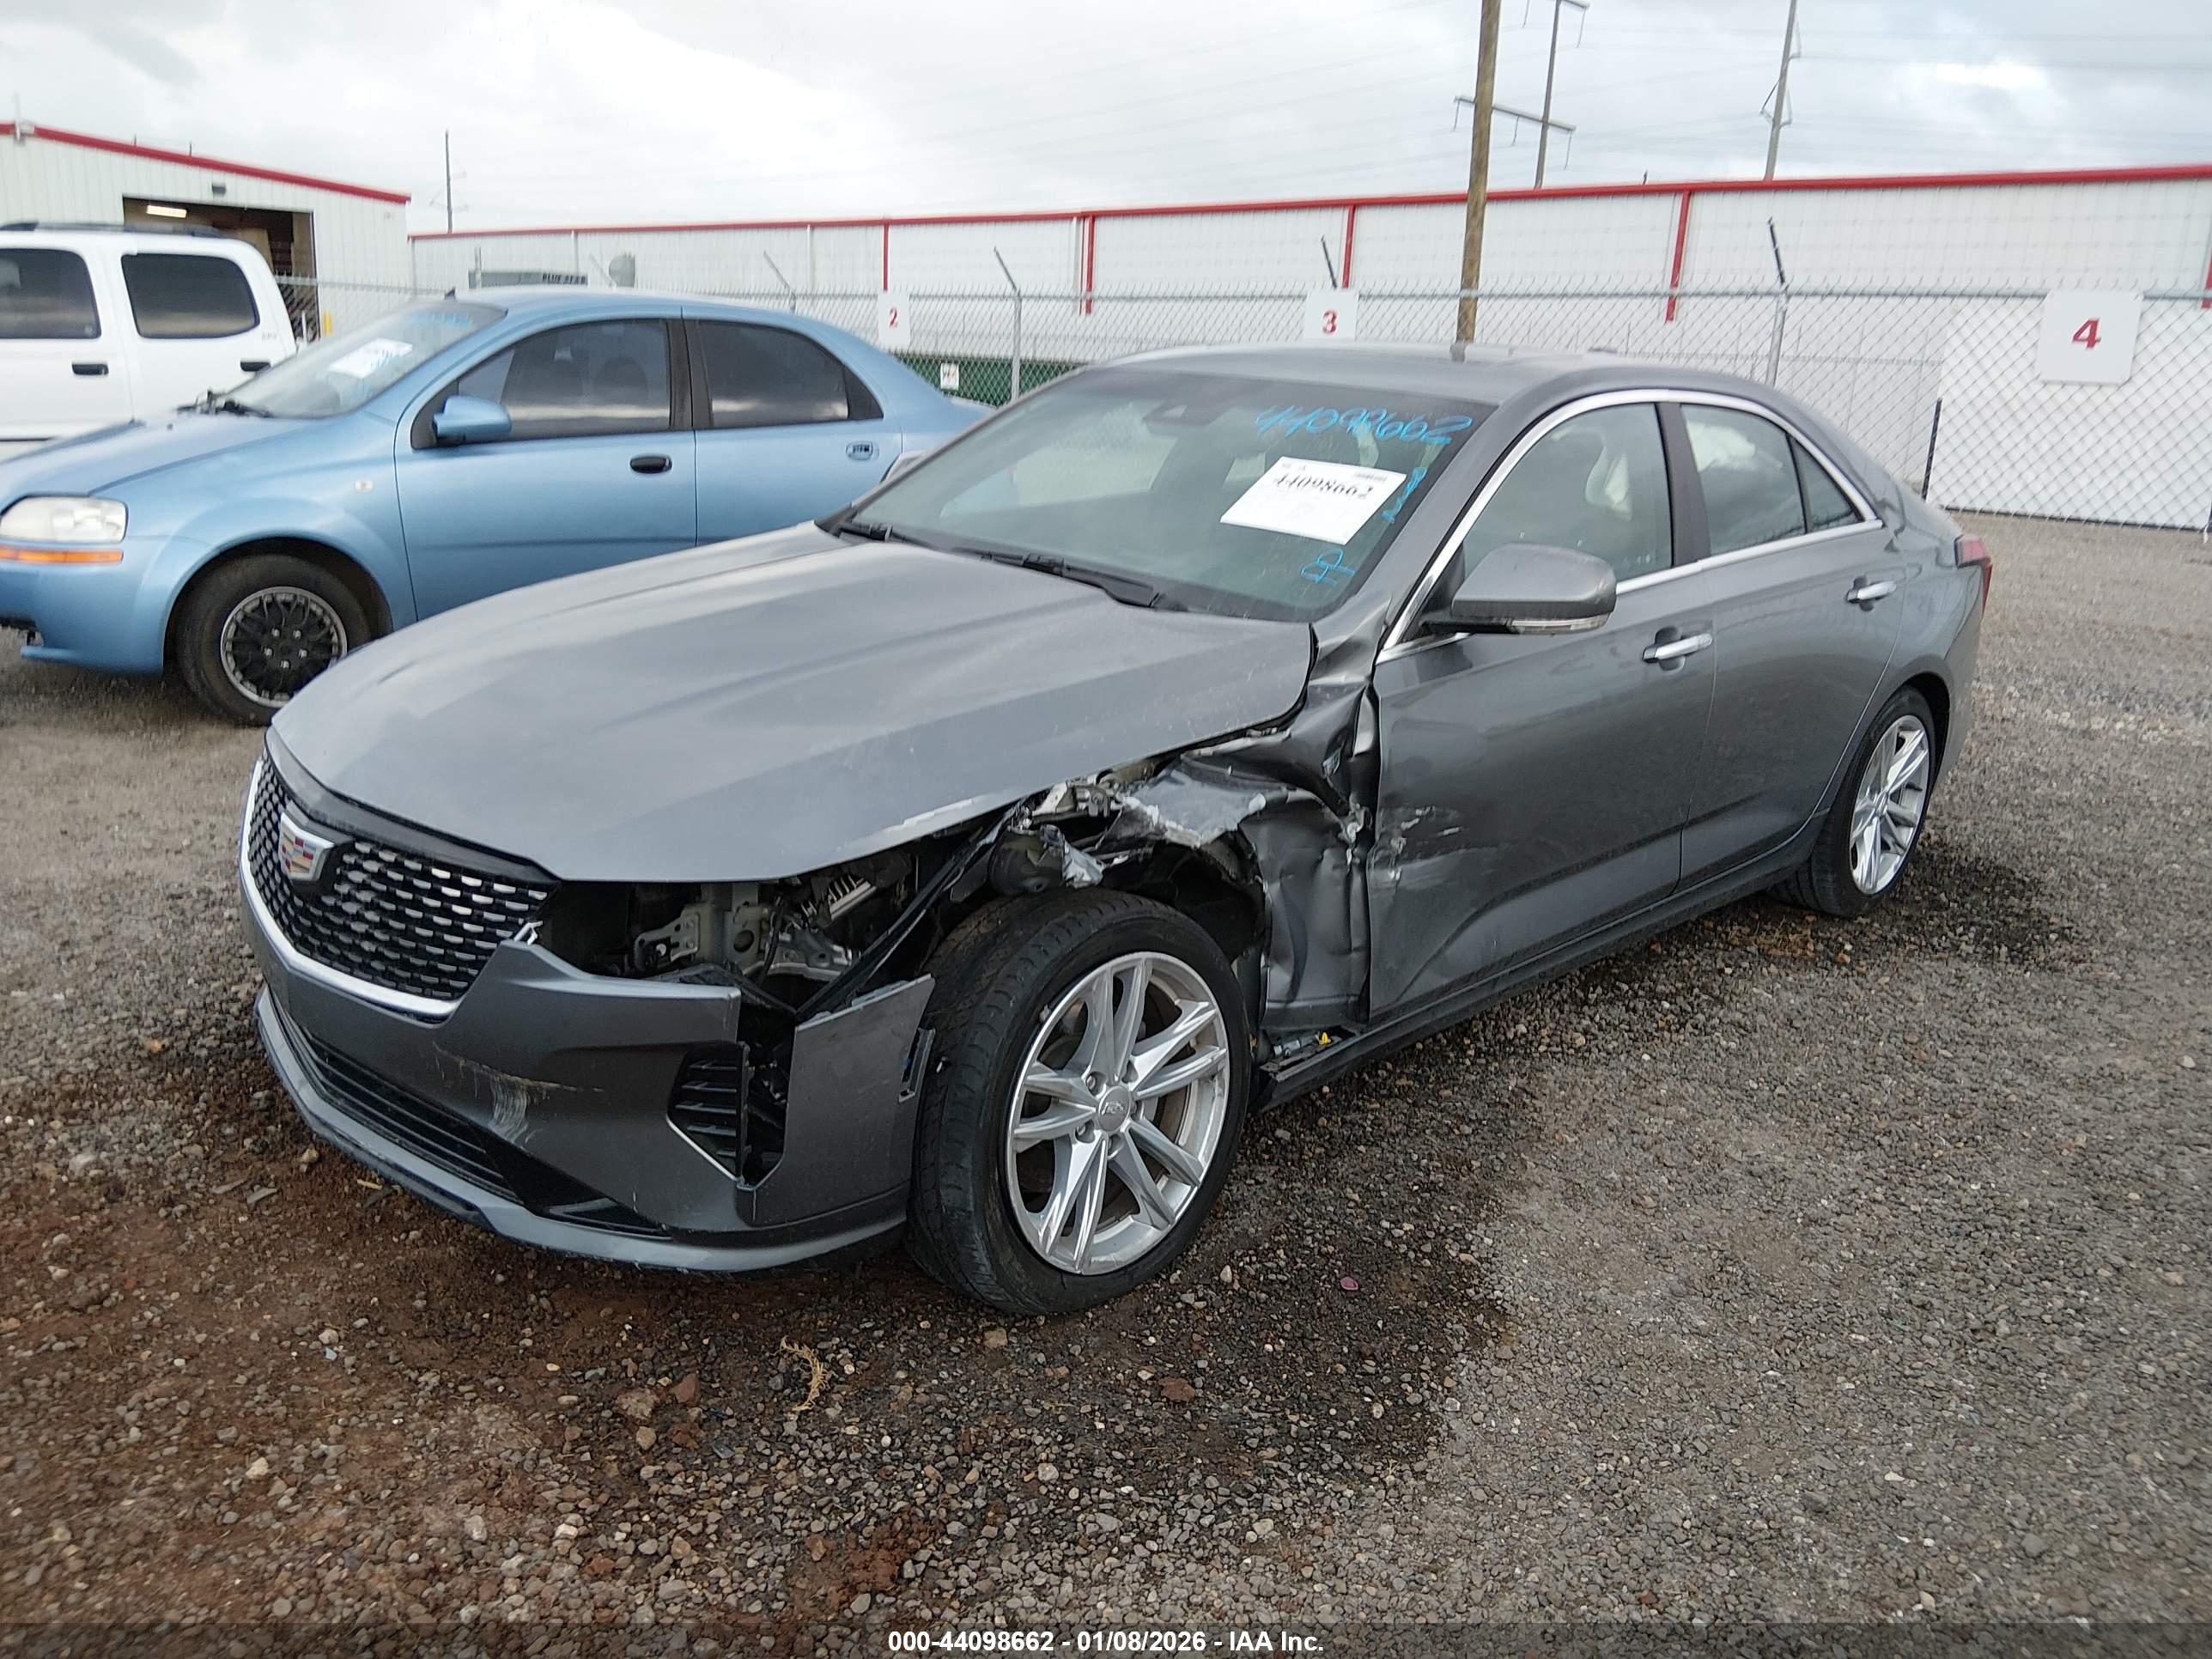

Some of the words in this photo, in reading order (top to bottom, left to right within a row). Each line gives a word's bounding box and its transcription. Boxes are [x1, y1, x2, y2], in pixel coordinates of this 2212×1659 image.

[889, 307, 898, 330] 2
[1322, 310, 1337, 335] 3
[2072, 318, 2101, 349] 4
